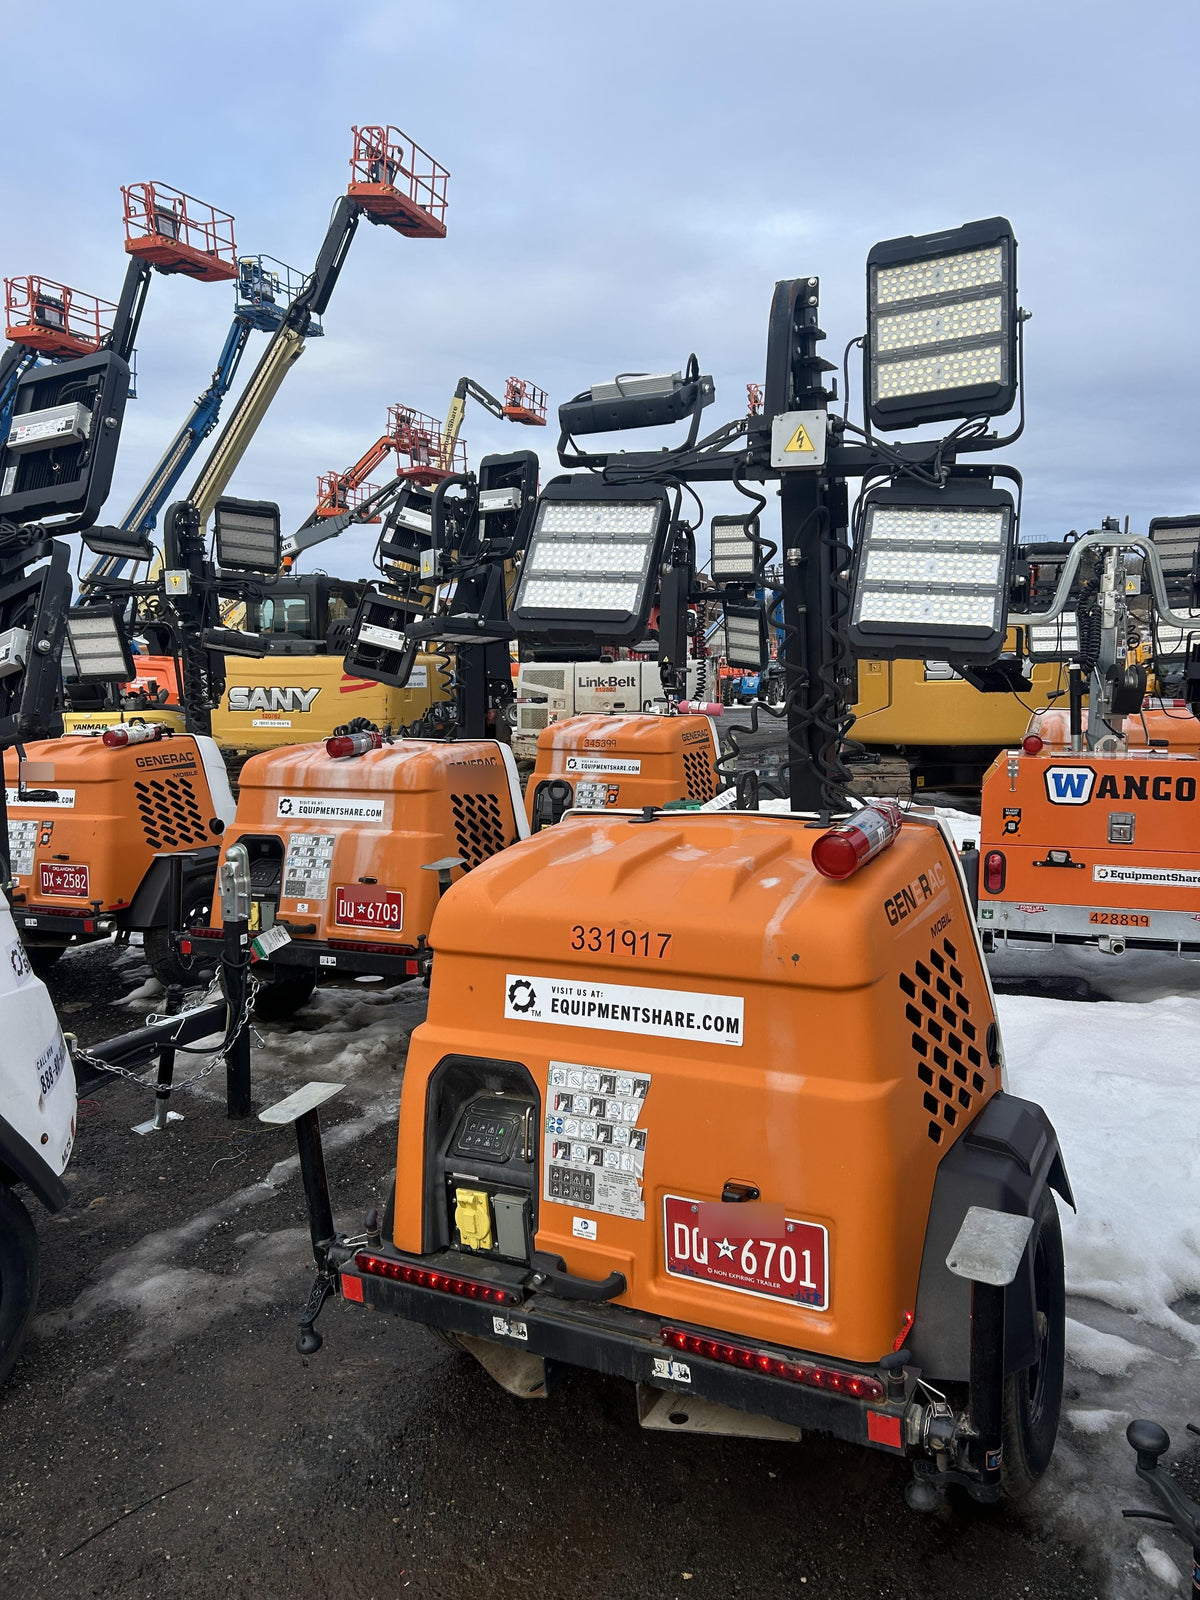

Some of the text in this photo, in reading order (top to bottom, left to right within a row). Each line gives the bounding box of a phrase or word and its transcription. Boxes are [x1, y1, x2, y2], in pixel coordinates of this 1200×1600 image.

[229, 687, 321, 712] SANY
[584, 739, 616, 747] 345399
[681, 729, 708, 741] GENERAC
[136, 752, 194, 767] GENERAC
[1051, 773, 1197, 802] WANCO
[298, 805, 382, 817] EQUIPMENTSHARE.COM
[43, 872, 86, 889] DX 2582
[884, 861, 947, 927] GENERAC
[367, 902, 398, 921] 6703
[1090, 912, 1149, 927] 428899
[571, 925, 672, 958] 331917
[551, 986, 604, 998] VISIT US AT:
[551, 998, 739, 1034] EQUIPMENTSHARE.COM
[674, 1222, 816, 1289] DQ 6701
[728, 1273, 755, 1283] EXPIRING
[757, 1279, 781, 1289] TRAILER
